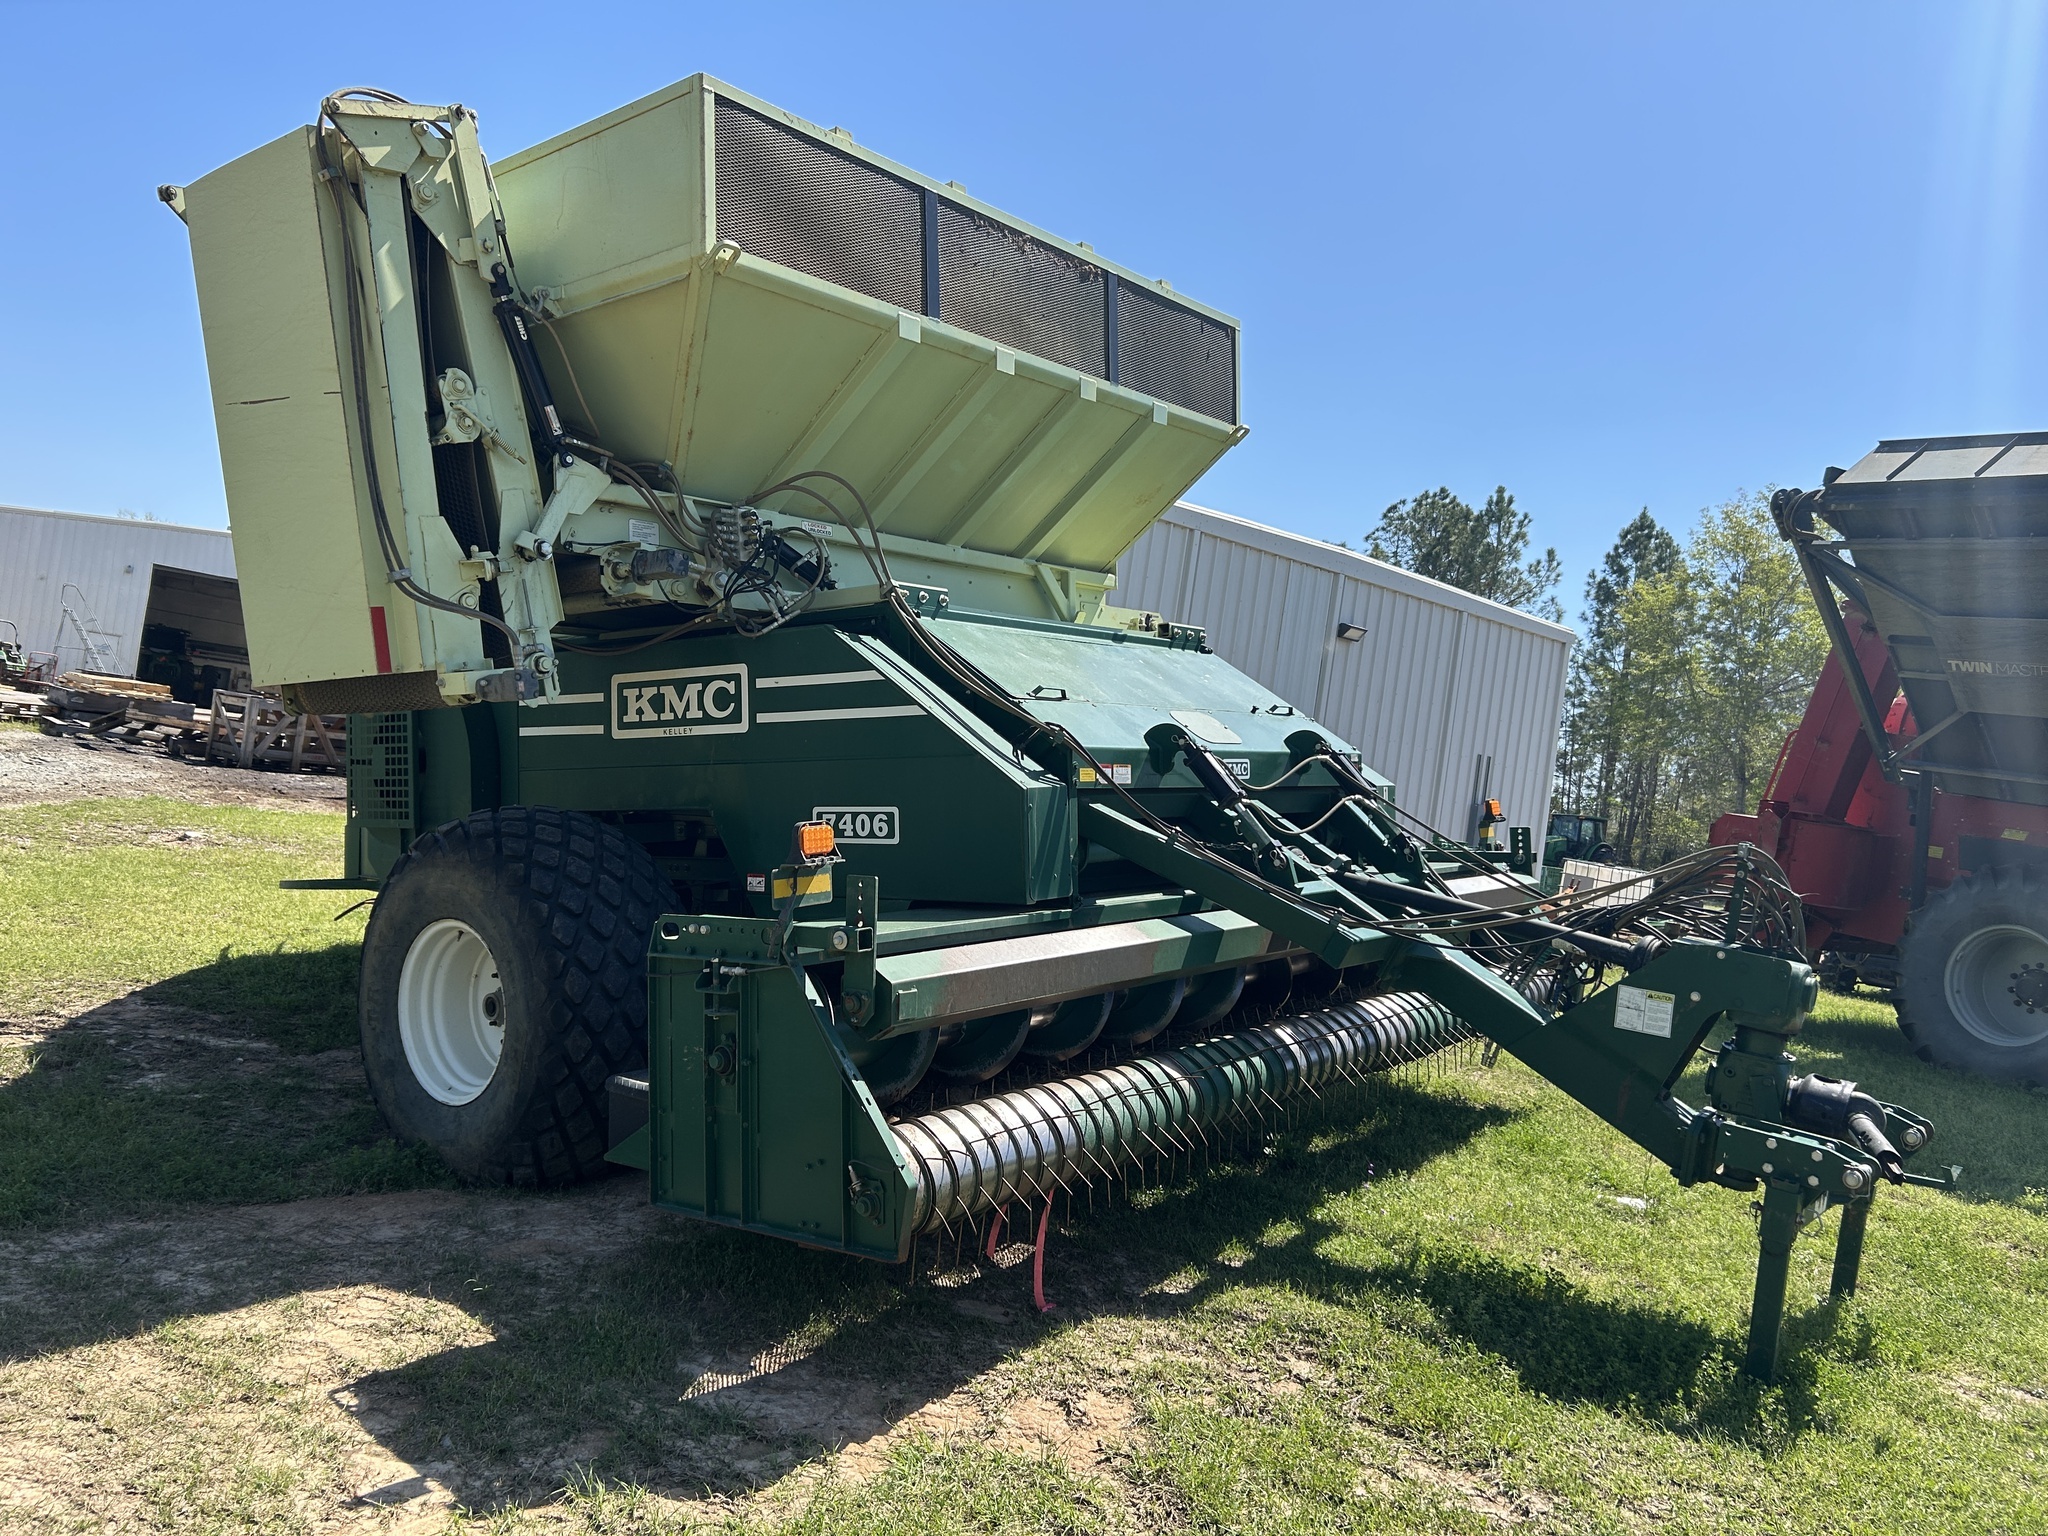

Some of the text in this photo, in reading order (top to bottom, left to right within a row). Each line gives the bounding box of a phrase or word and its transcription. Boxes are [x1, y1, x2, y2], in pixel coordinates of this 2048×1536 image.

[514, 315, 528, 341] CHIEF
[1947, 660, 1993, 674] TWIN
[622, 679, 736, 723] KMC
[663, 727, 693, 736] KELLEY
[822, 813, 889, 838] 7406
[1653, 993, 1674, 1002] CAUTION
